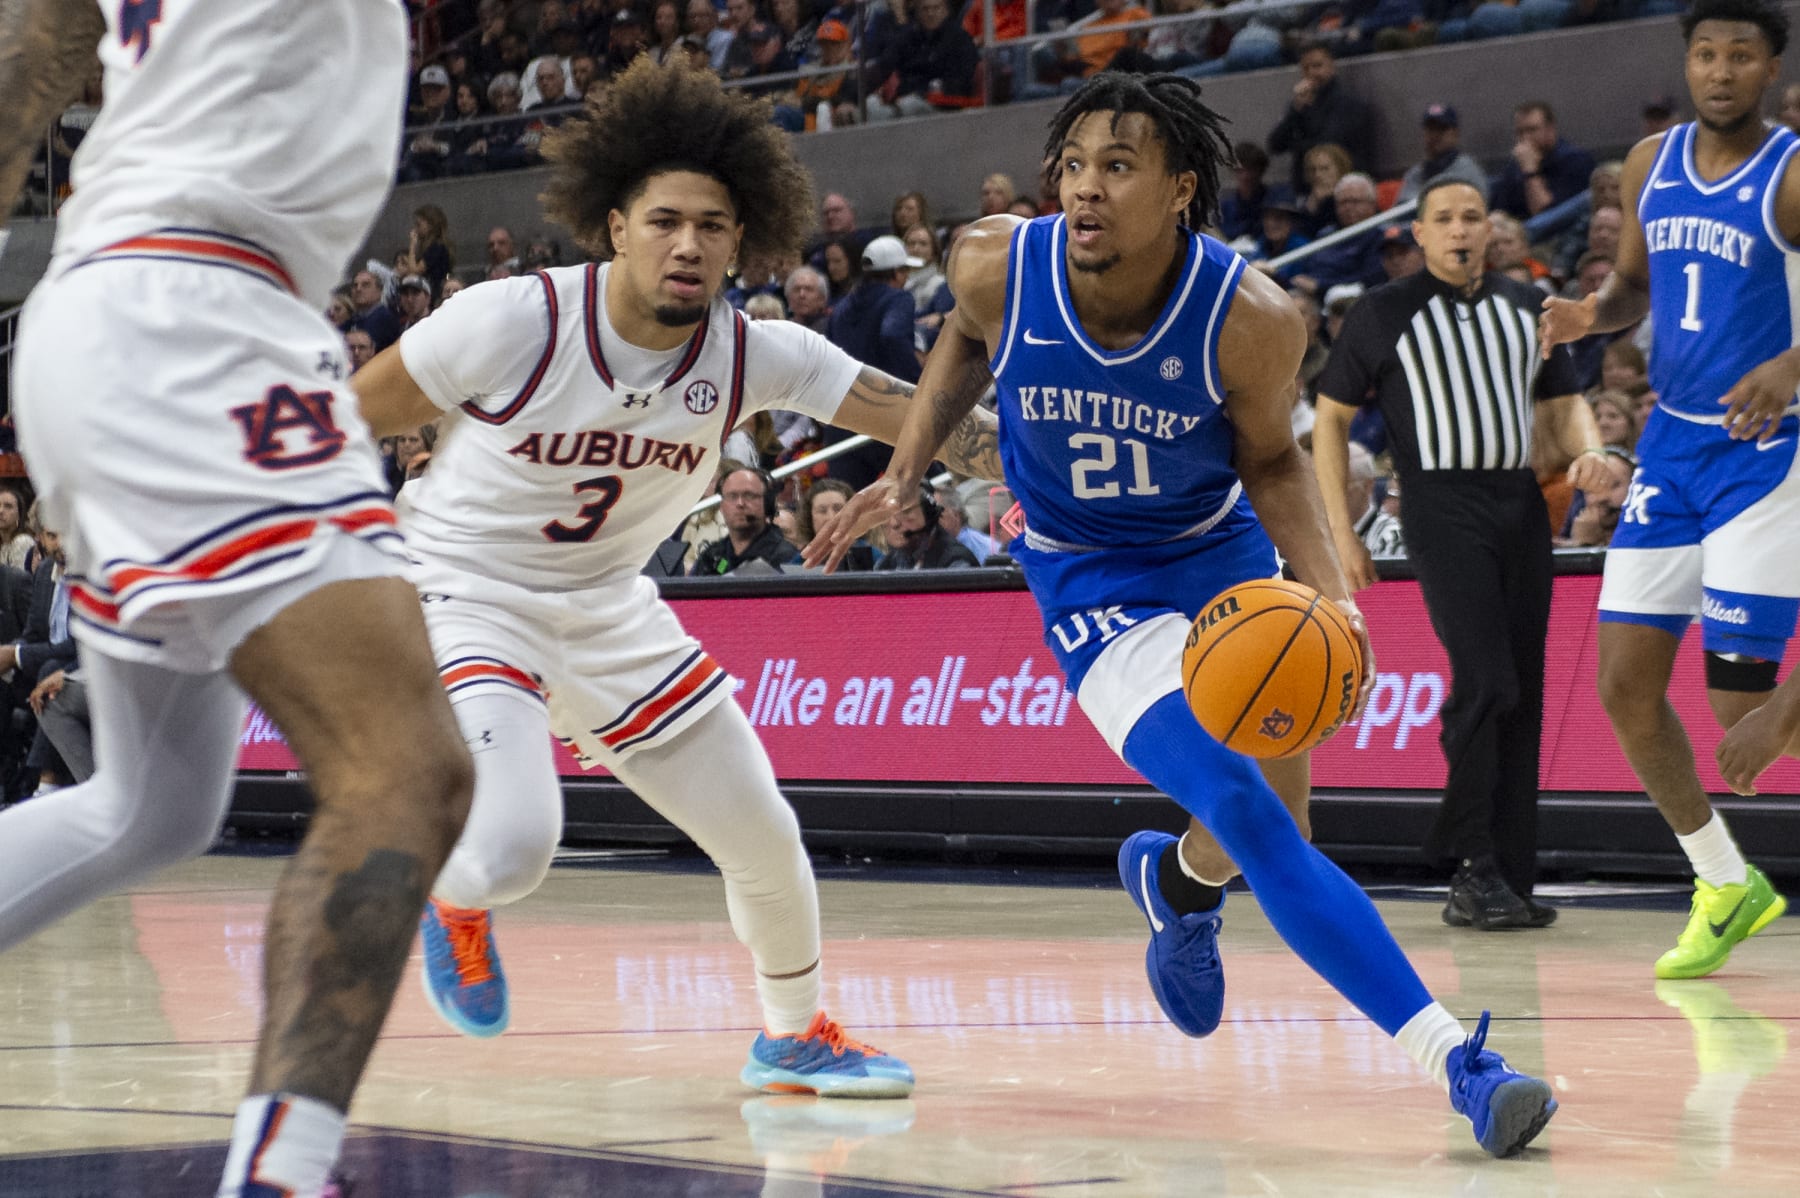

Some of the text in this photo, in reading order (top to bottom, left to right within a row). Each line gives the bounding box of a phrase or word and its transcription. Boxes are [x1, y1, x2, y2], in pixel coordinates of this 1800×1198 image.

[1645, 216, 1755, 268] KENTUCKY
[1680, 262, 1702, 332] 1
[1162, 359, 1181, 378] SEC
[686, 382, 717, 413] SEC
[1018, 386, 1200, 440] KENTUCKY
[506, 430, 707, 475] AUBURN
[1068, 432, 1160, 499] 21
[541, 474, 623, 542] 3
[1052, 604, 1138, 653] UK
[748, 658, 827, 726] like
[834, 677, 893, 726] an
[1344, 672, 1445, 749] pp
